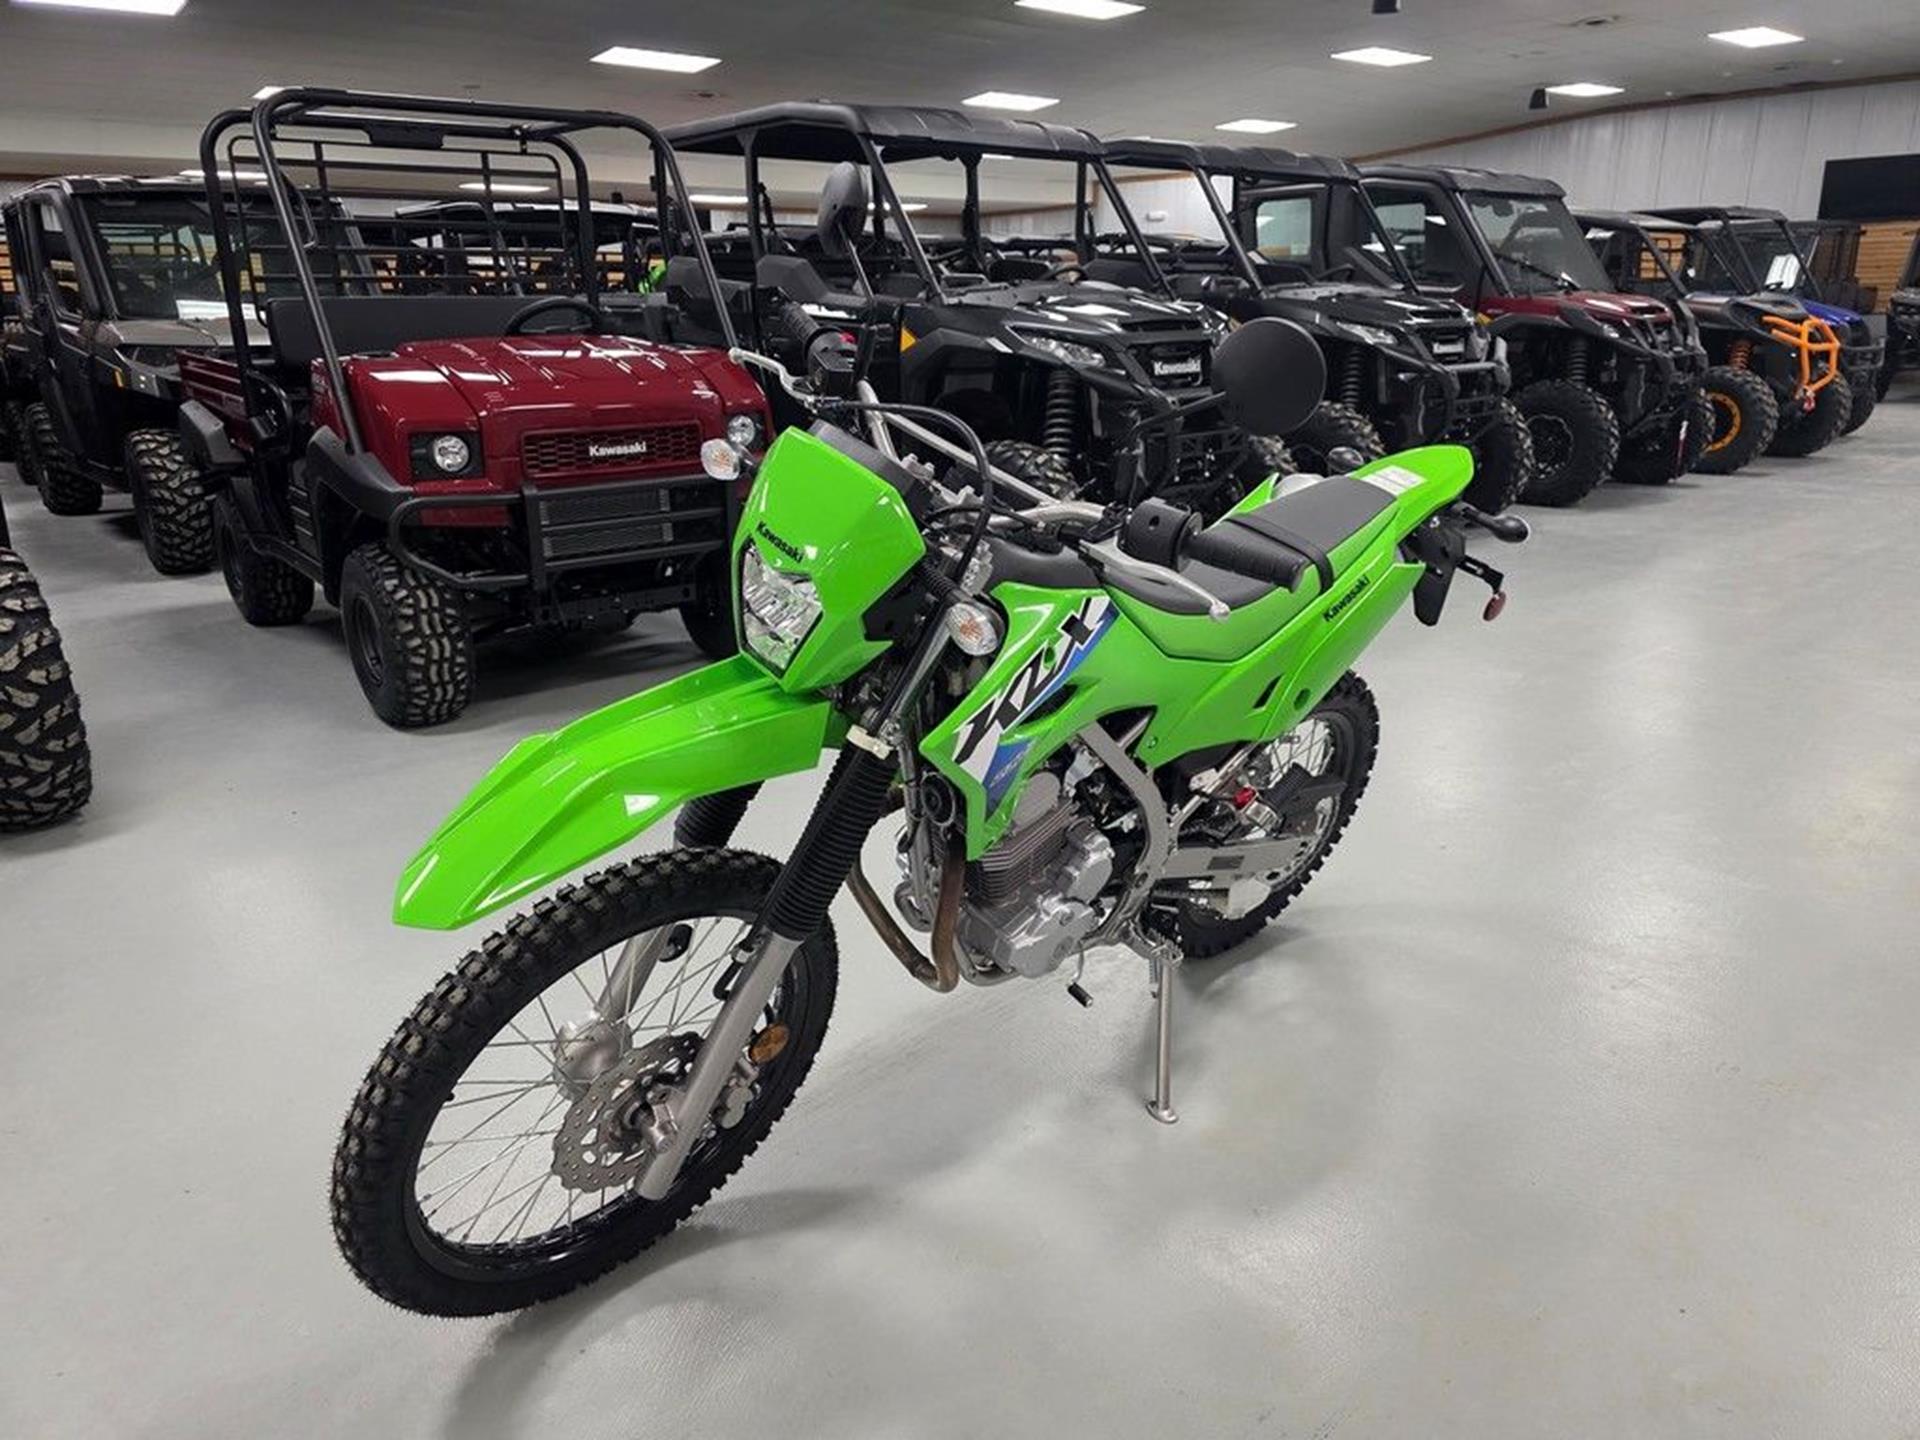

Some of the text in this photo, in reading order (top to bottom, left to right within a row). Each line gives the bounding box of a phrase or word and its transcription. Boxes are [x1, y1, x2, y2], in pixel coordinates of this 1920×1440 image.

[589, 441, 646, 457] Kawasaki
[757, 521, 804, 563] Kawasaki
[1323, 575, 1370, 622] Kawasaki
